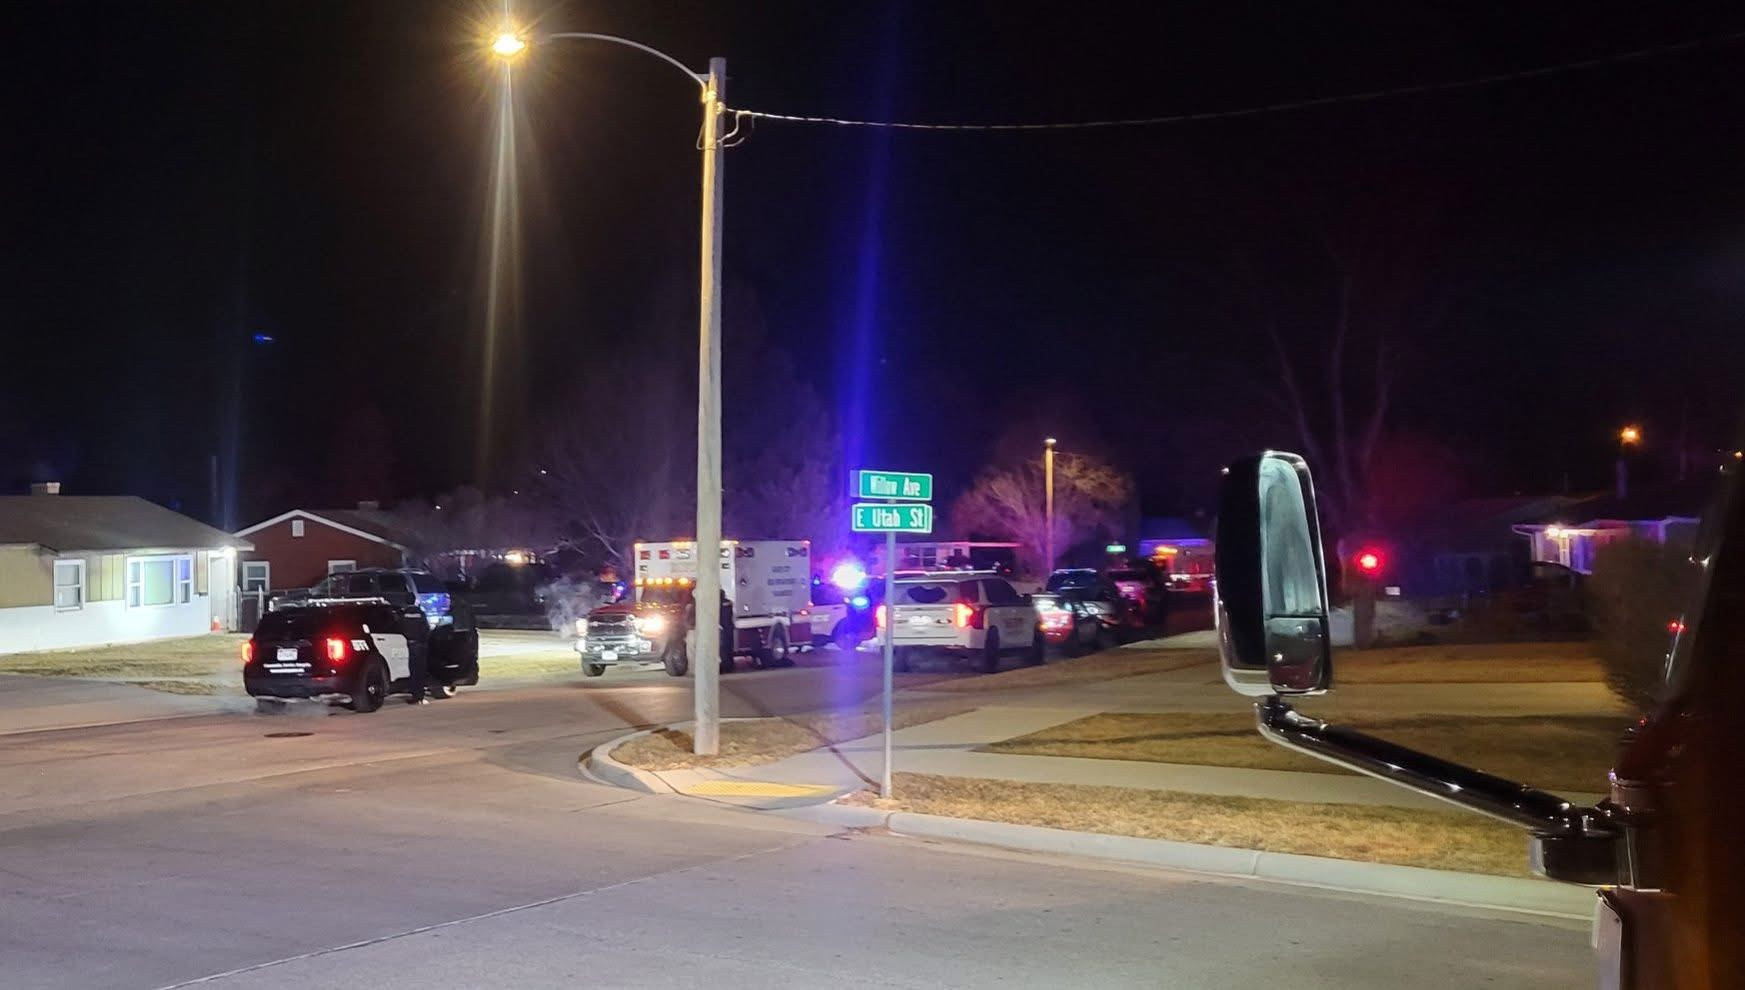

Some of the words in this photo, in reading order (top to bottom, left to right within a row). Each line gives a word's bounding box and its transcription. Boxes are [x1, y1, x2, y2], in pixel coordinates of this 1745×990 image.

[902, 476, 921, 497] Ave
[856, 508, 865, 528] E
[872, 508, 901, 528] Utah
[909, 507, 924, 528] St
